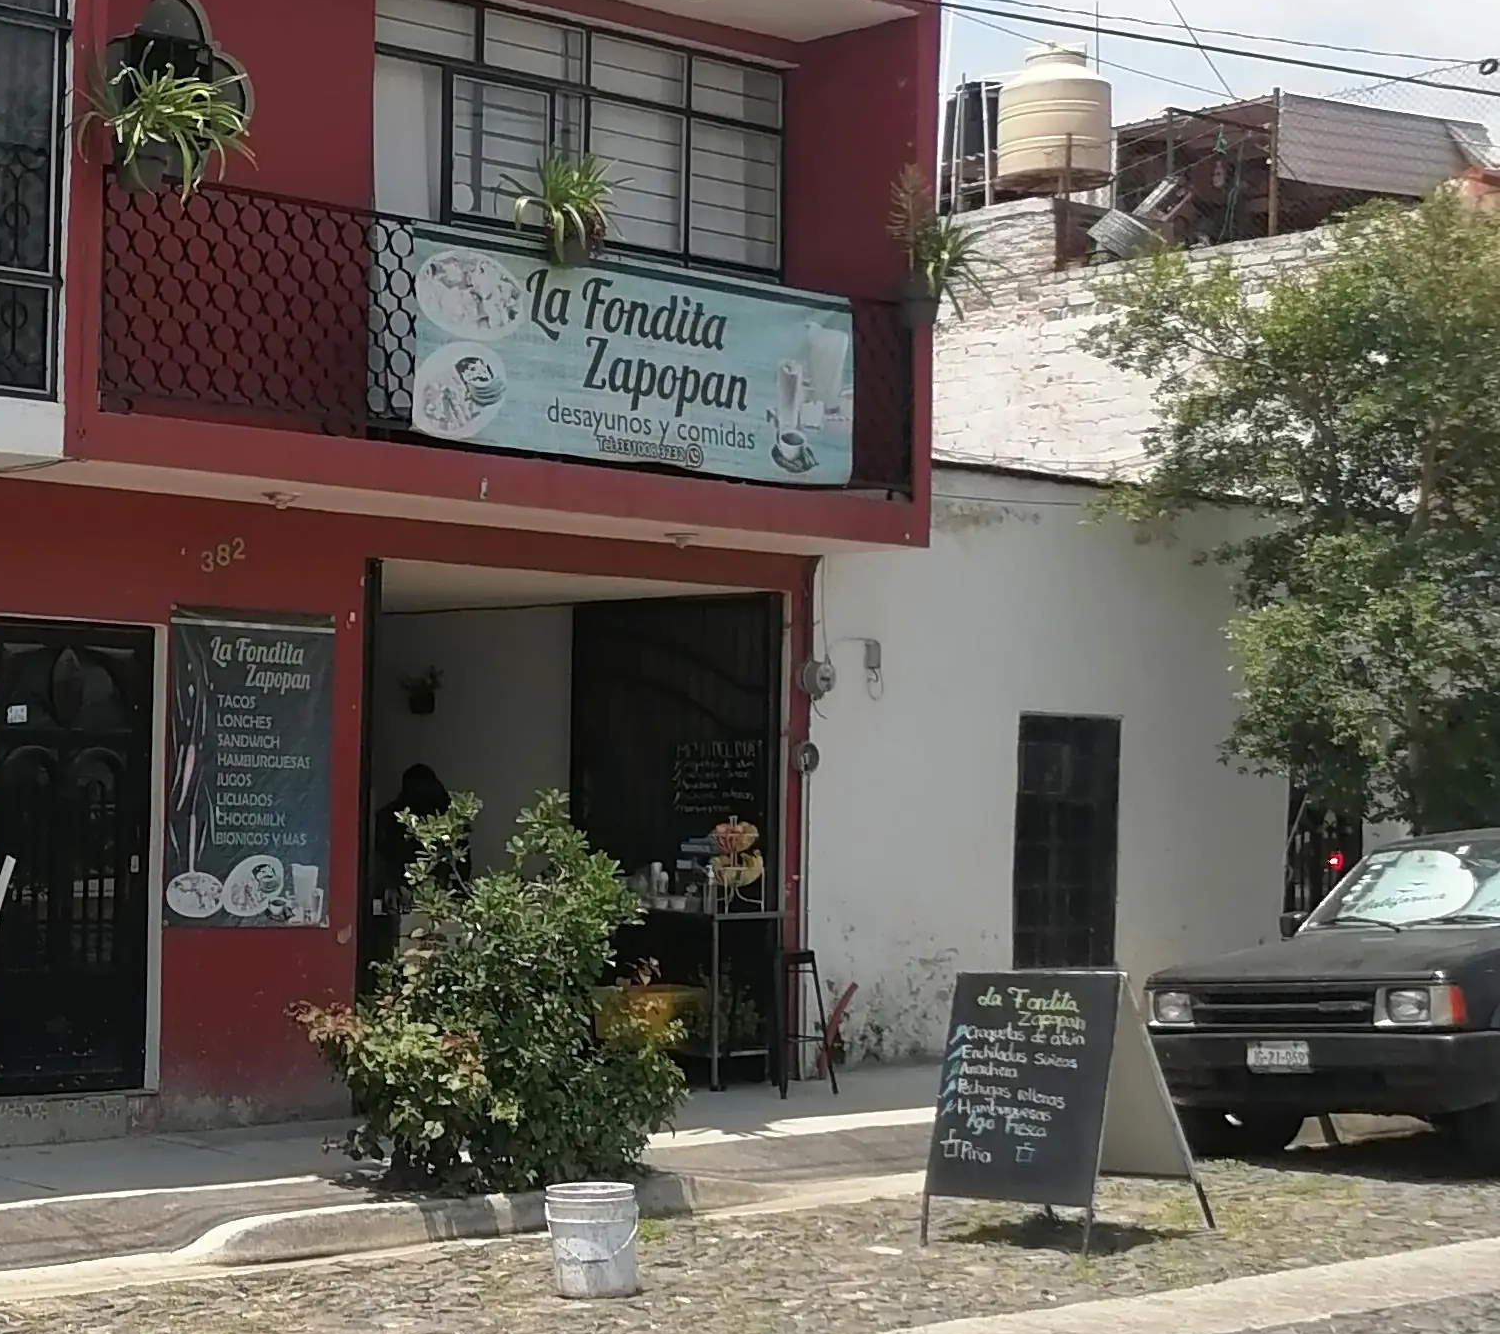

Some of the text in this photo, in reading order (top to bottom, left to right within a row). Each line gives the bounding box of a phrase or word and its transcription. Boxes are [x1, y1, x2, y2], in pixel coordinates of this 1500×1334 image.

[526, 269, 728, 351] La Fondita
[583, 336, 748, 417] Zapopan
[547, 397, 756, 450] desayunos y comidas
[201, 536, 246, 573] 382
[210, 636, 305, 668] La Fondita
[245, 664, 312, 696] Zapopan
[217, 694, 257, 709] TACOS
[217, 713, 272, 730] LONCHES
[217, 733, 280, 749] SANDWICH
[217, 752, 312, 770] HAMBURGUESAS
[216, 792, 273, 807] LICUADOS
[1007, 986, 1081, 1013] Fondita
[1017, 1010, 1086, 1034] Zapopan
[961, 1042, 1028, 1064] Enchiladas
